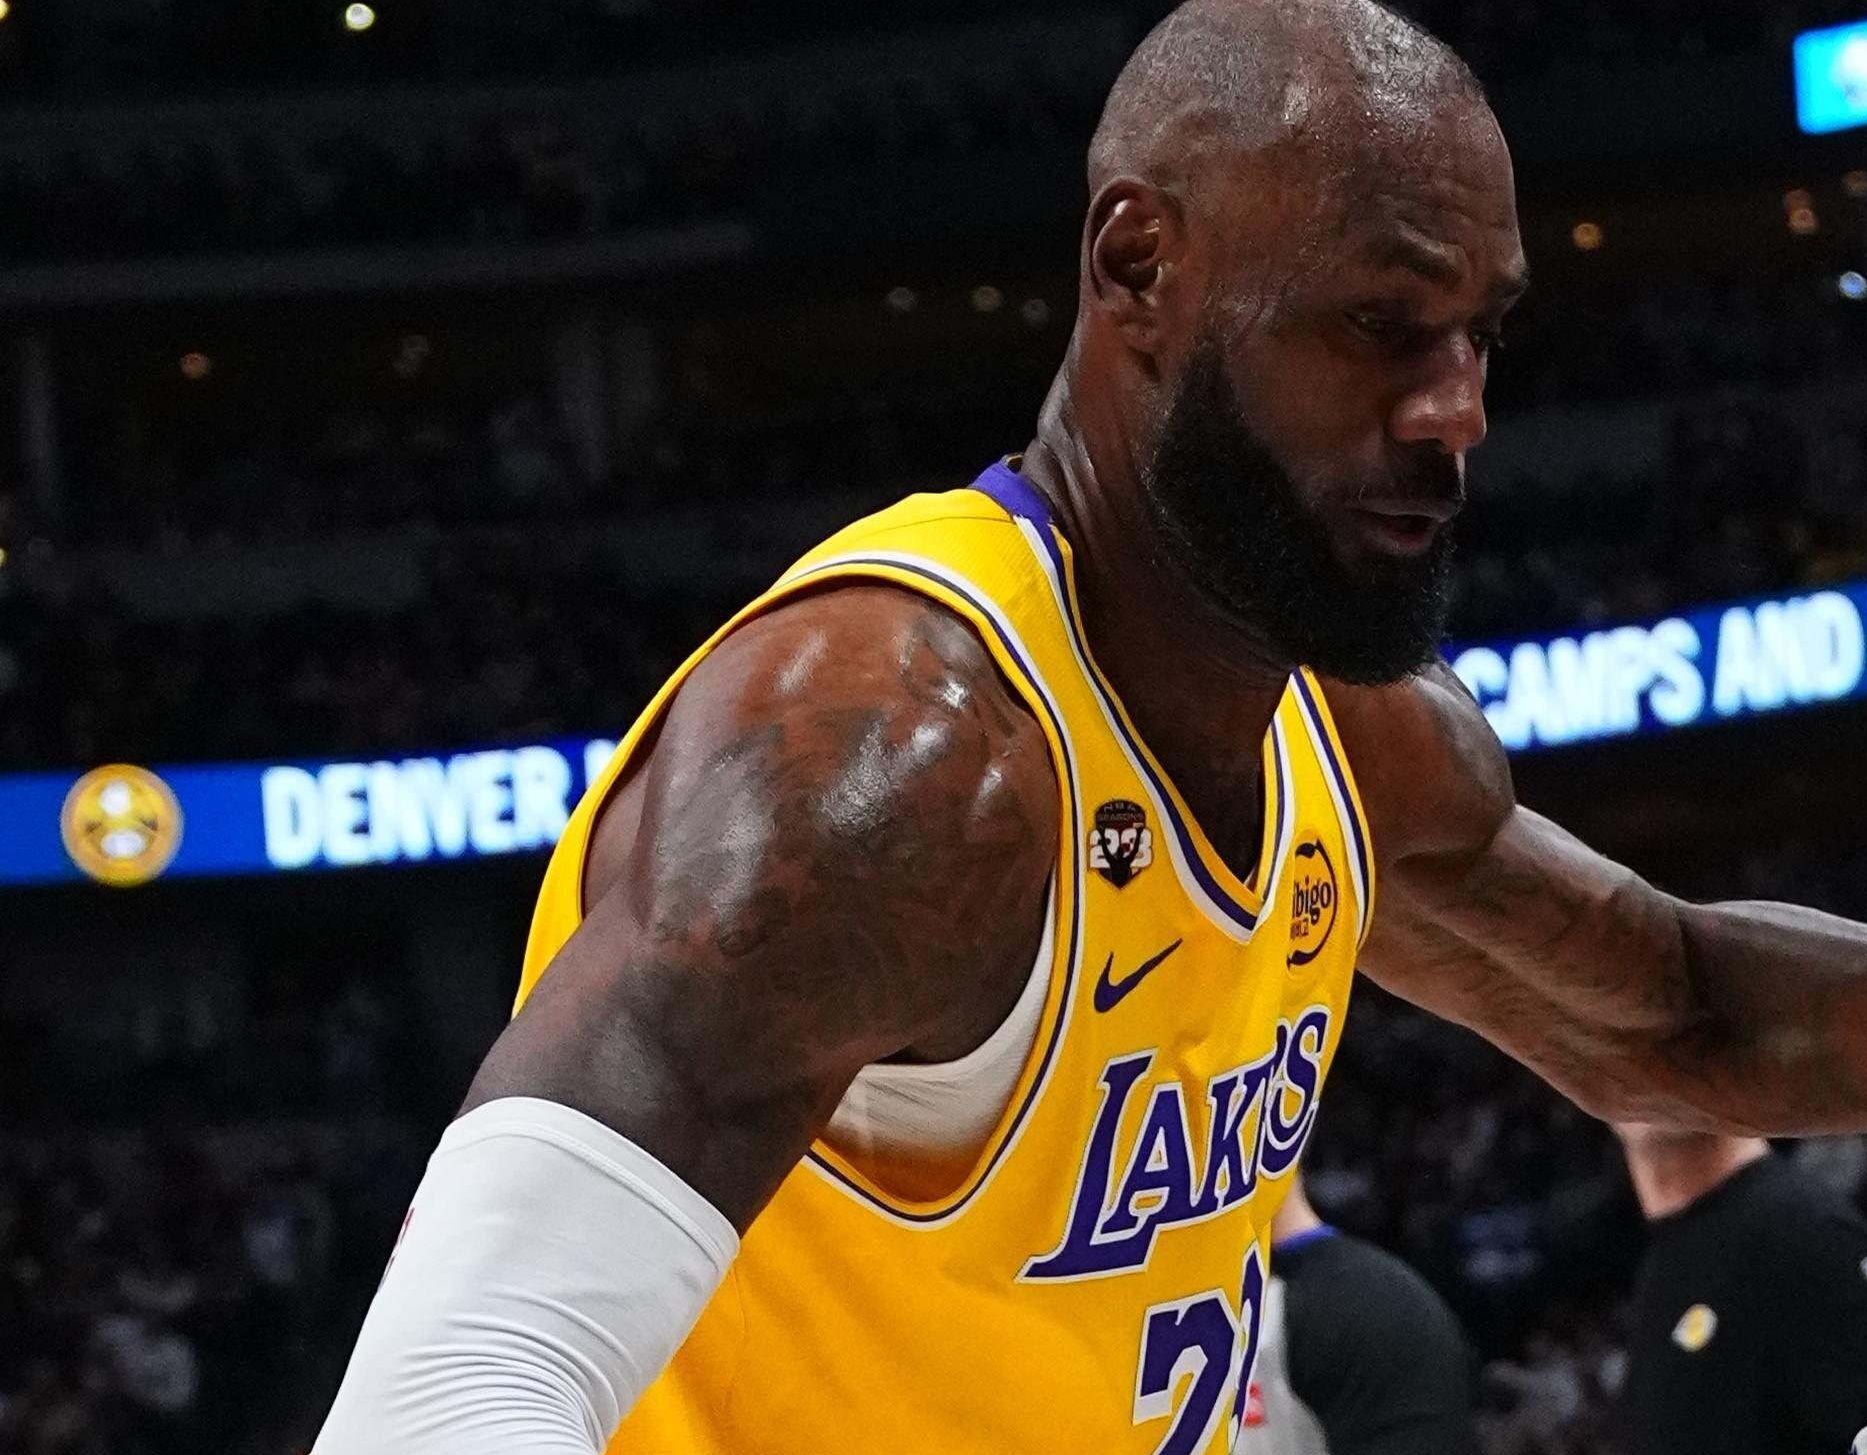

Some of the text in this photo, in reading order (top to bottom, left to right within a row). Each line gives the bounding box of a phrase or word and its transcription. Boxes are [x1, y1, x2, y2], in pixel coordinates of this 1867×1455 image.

[1711, 591, 1865, 717] AND
[260, 744, 572, 870] DENVER
[1292, 874, 1332, 926] bigo
[1014, 1003, 1330, 1284] LAKS
